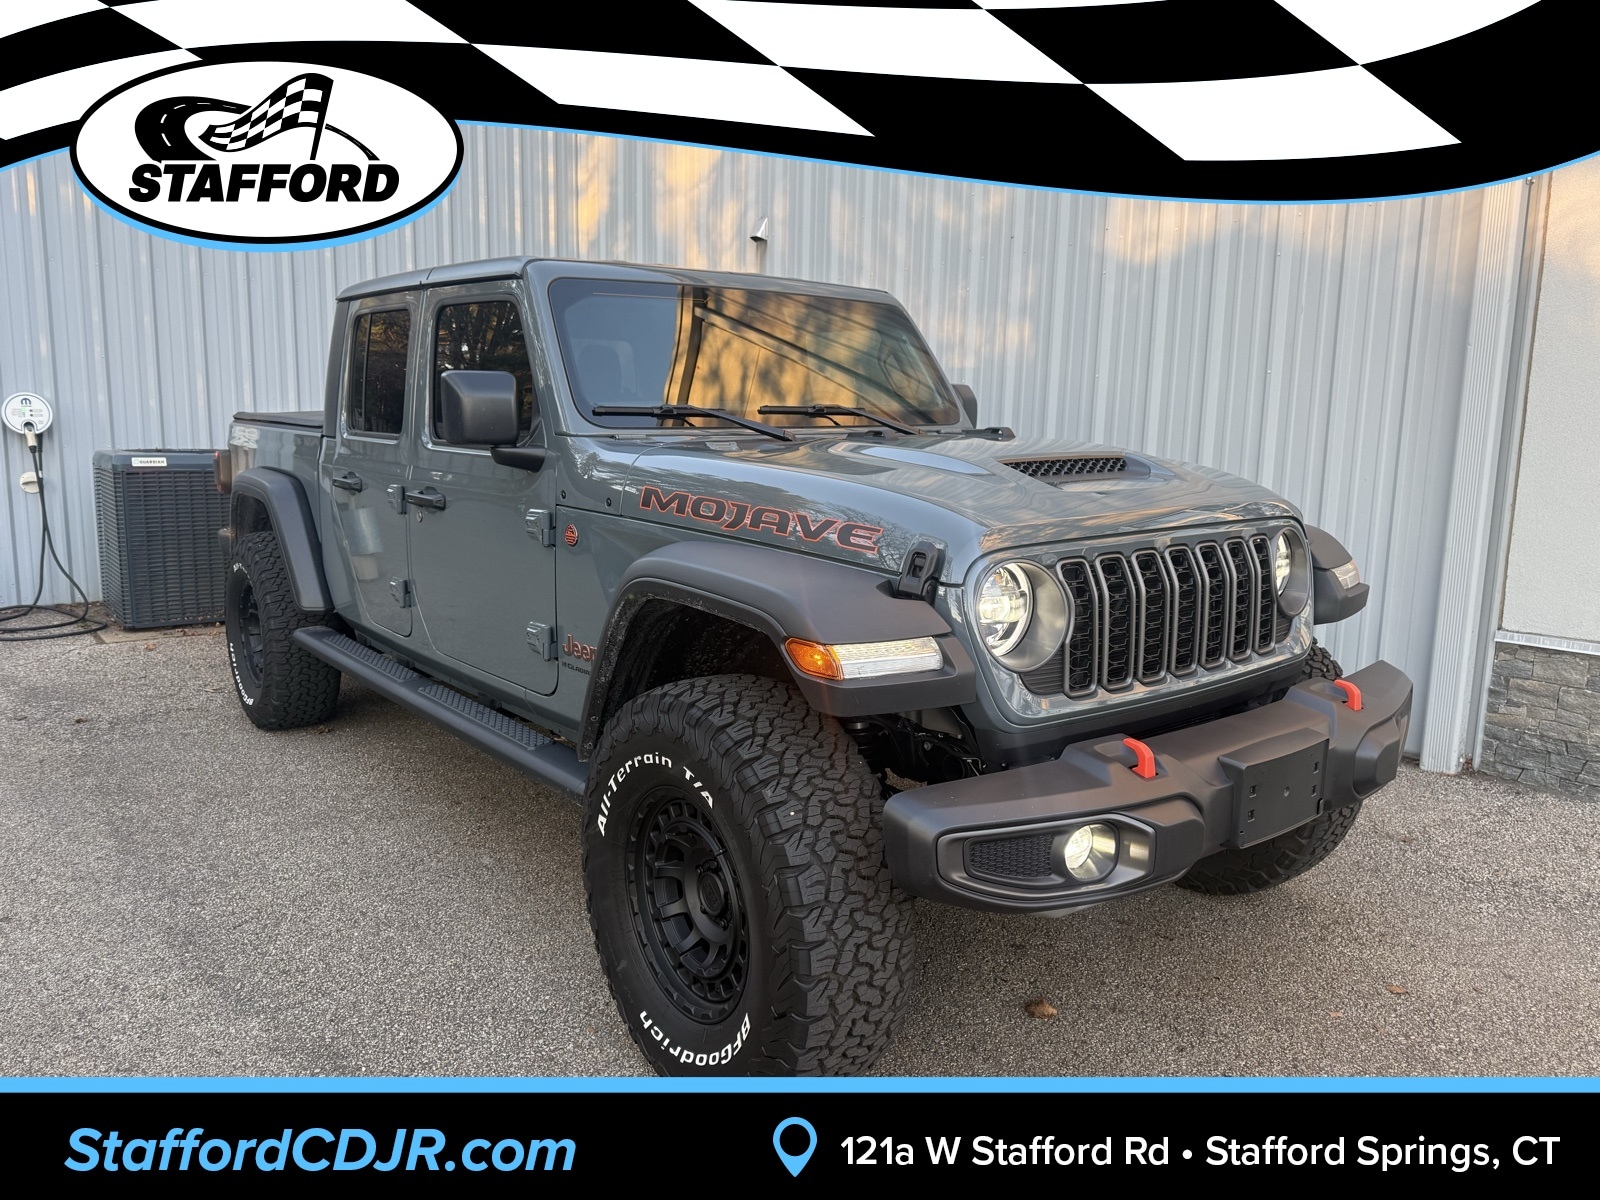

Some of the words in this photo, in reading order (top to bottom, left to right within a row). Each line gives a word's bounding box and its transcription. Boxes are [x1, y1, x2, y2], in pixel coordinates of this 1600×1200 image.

[639, 485, 884, 554] MOJAVE
[567, 662, 590, 676] GLADIA
[597, 752, 672, 837] All-Terrain
[683, 766, 714, 809] T/A
[639, 1010, 751, 1066] BFGoodrich
